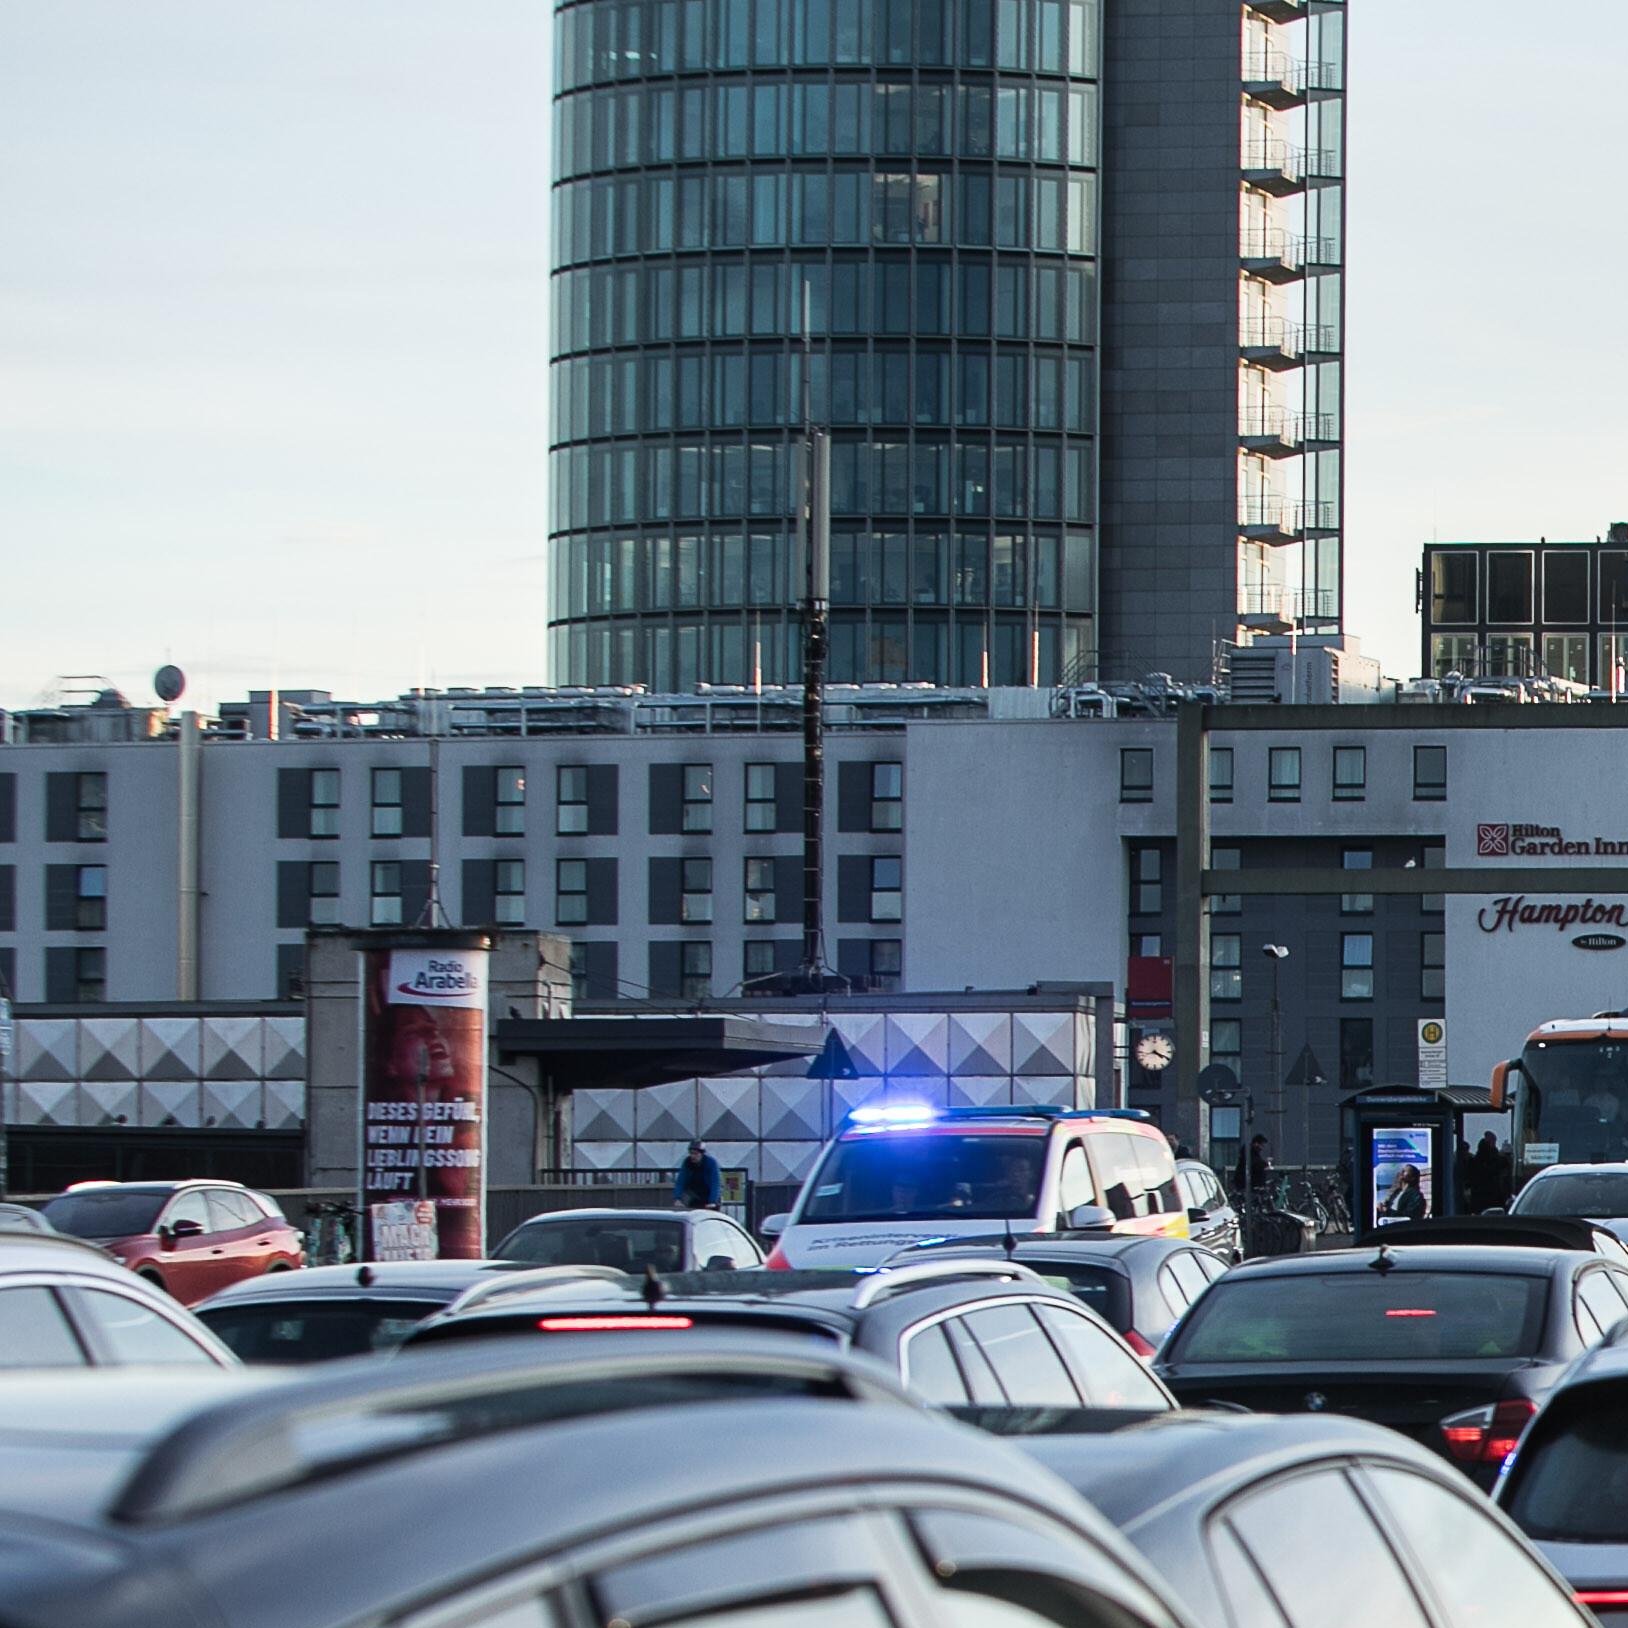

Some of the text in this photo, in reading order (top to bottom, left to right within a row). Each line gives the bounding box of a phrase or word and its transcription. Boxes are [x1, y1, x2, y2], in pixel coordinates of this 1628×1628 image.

[1511, 824, 1560, 837] Hilton
[1511, 838, 1590, 855] Garden
[1588, 933, 1617, 945] Hilton
[428, 959, 464, 973] Radio
[415, 971, 479, 989] Arabella
[367, 1125, 411, 1144] WENN
[367, 1169, 415, 1190] LÄUFT
